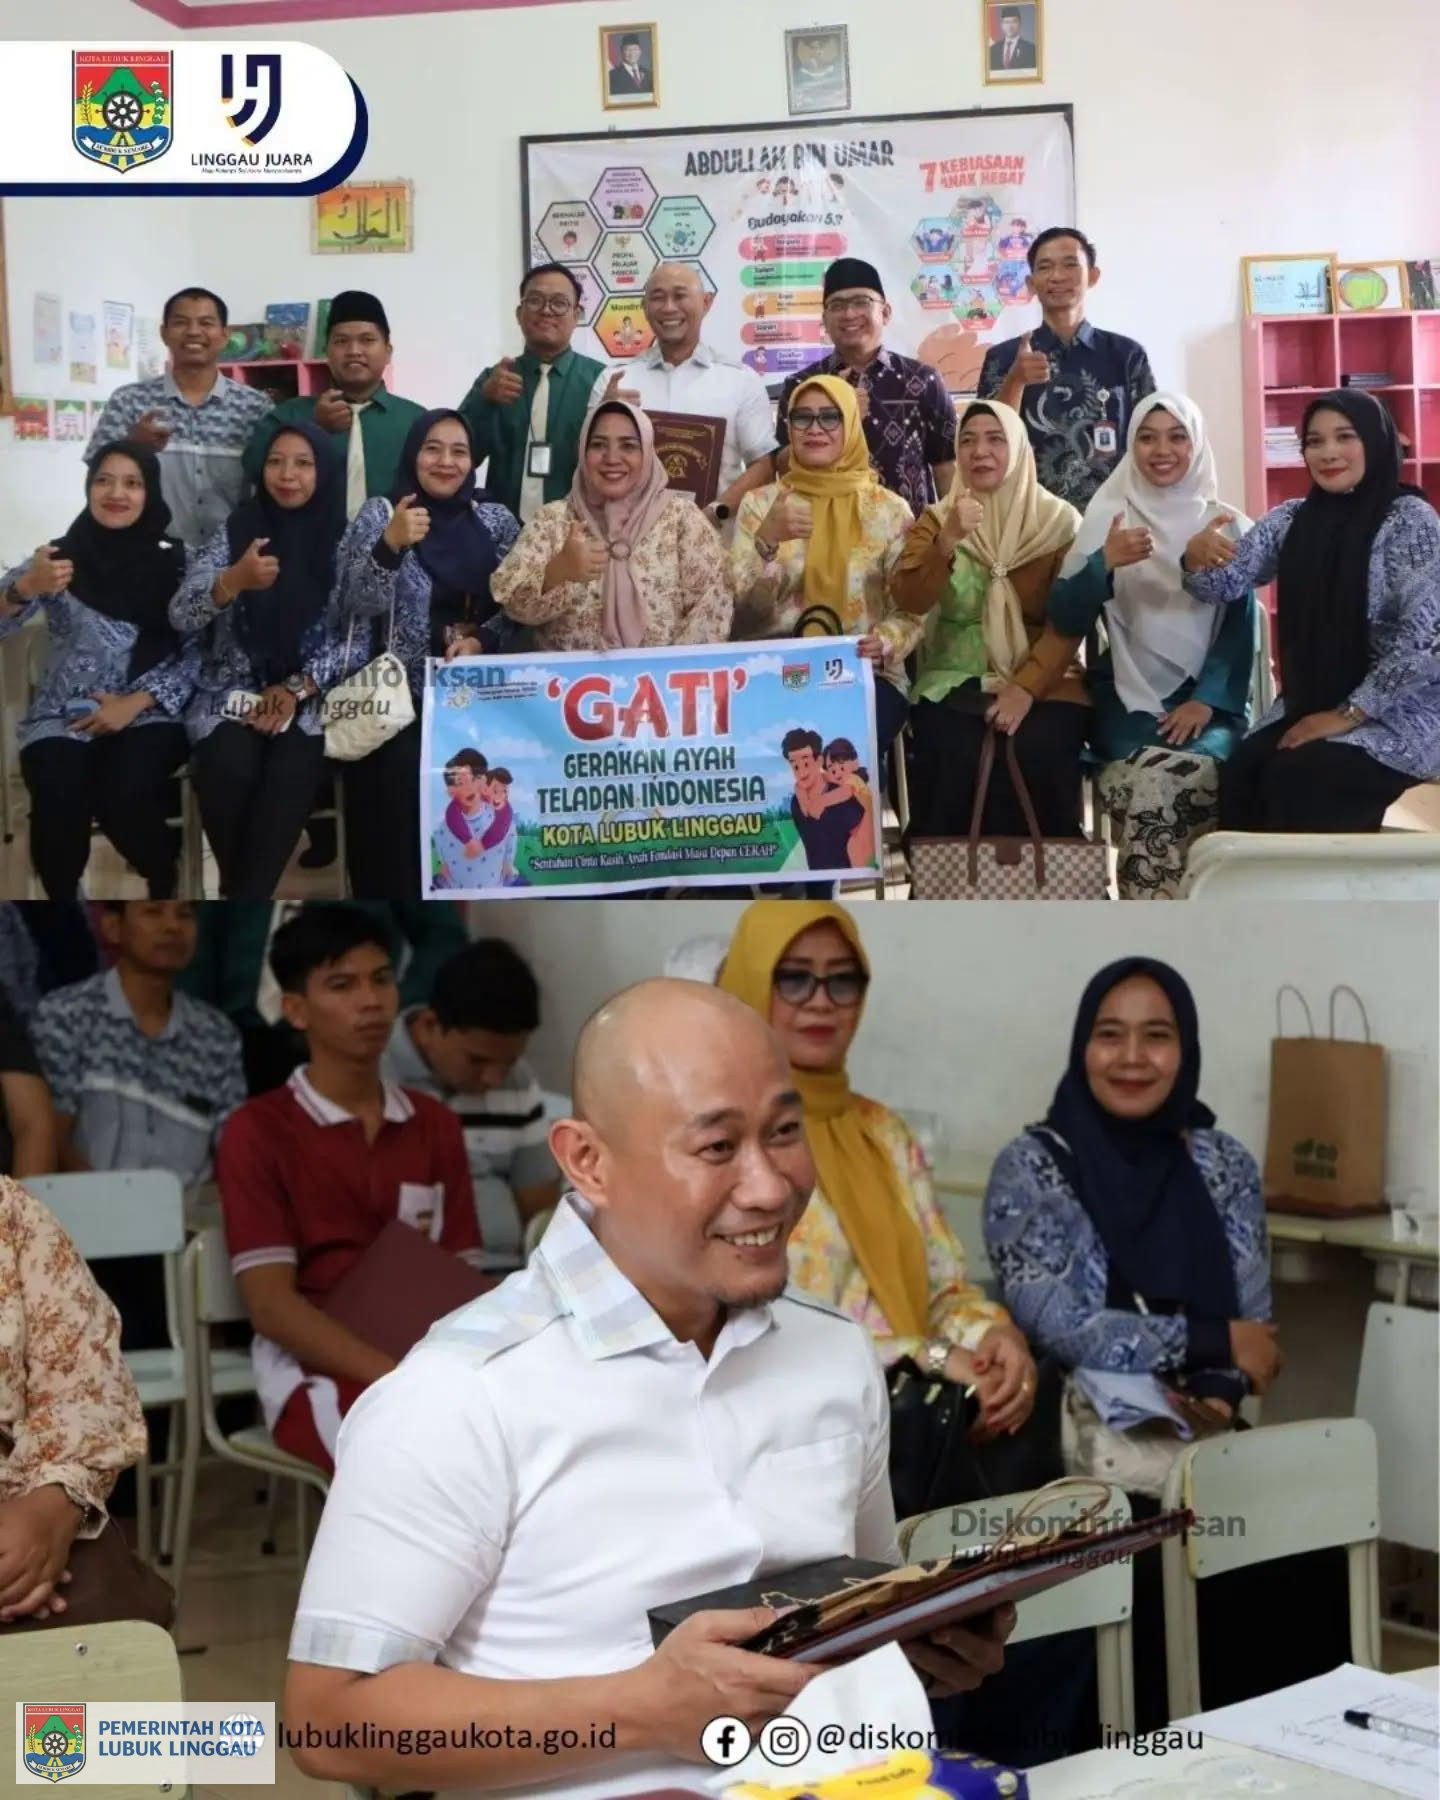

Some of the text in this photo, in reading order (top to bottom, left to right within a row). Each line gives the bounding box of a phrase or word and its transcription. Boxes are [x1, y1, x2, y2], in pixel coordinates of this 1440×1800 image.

[684, 145, 786, 177] ABDULLAH
[834, 139, 895, 168] UMAR
[919, 154, 1025, 193] 7 KEBIASAAN
[980, 171, 1025, 186] HEBAT
[563, 745, 737, 780] GERAKAN AYAH
[537, 776, 766, 814] TELADAN INDONESIA
[543, 813, 763, 848] KOTA LUBUK LINGGAU
